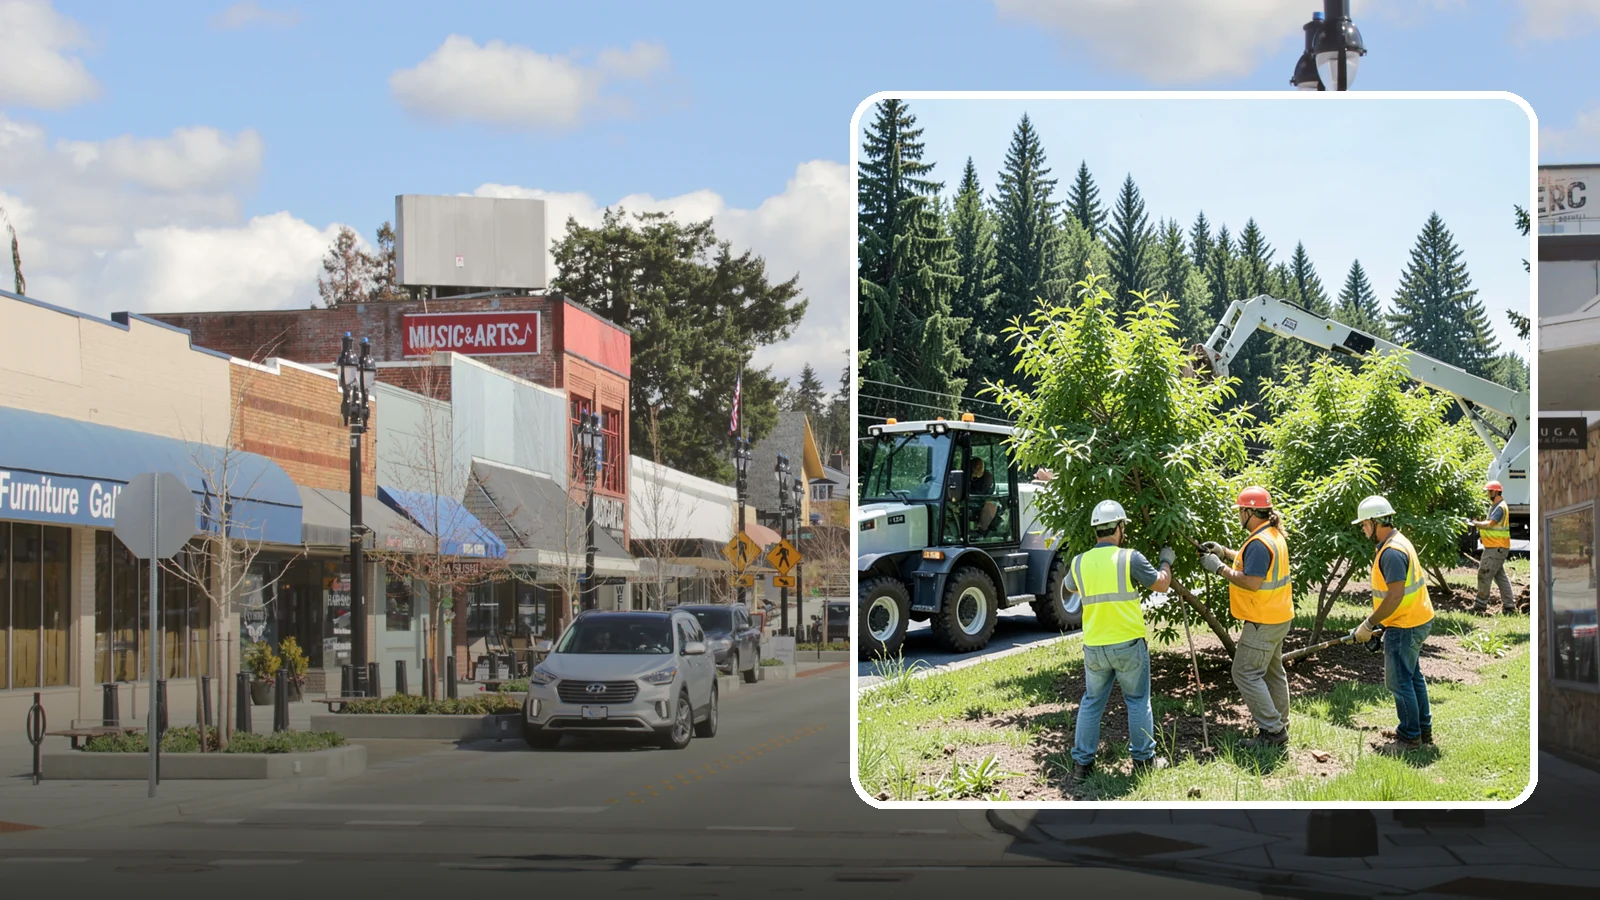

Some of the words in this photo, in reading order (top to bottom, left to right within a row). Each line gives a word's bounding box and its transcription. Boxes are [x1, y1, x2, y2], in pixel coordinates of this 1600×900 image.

[1541, 428, 1577, 436] UGA
[0, 471, 79, 515] Furniture
[89, 483, 122, 519] Gal
